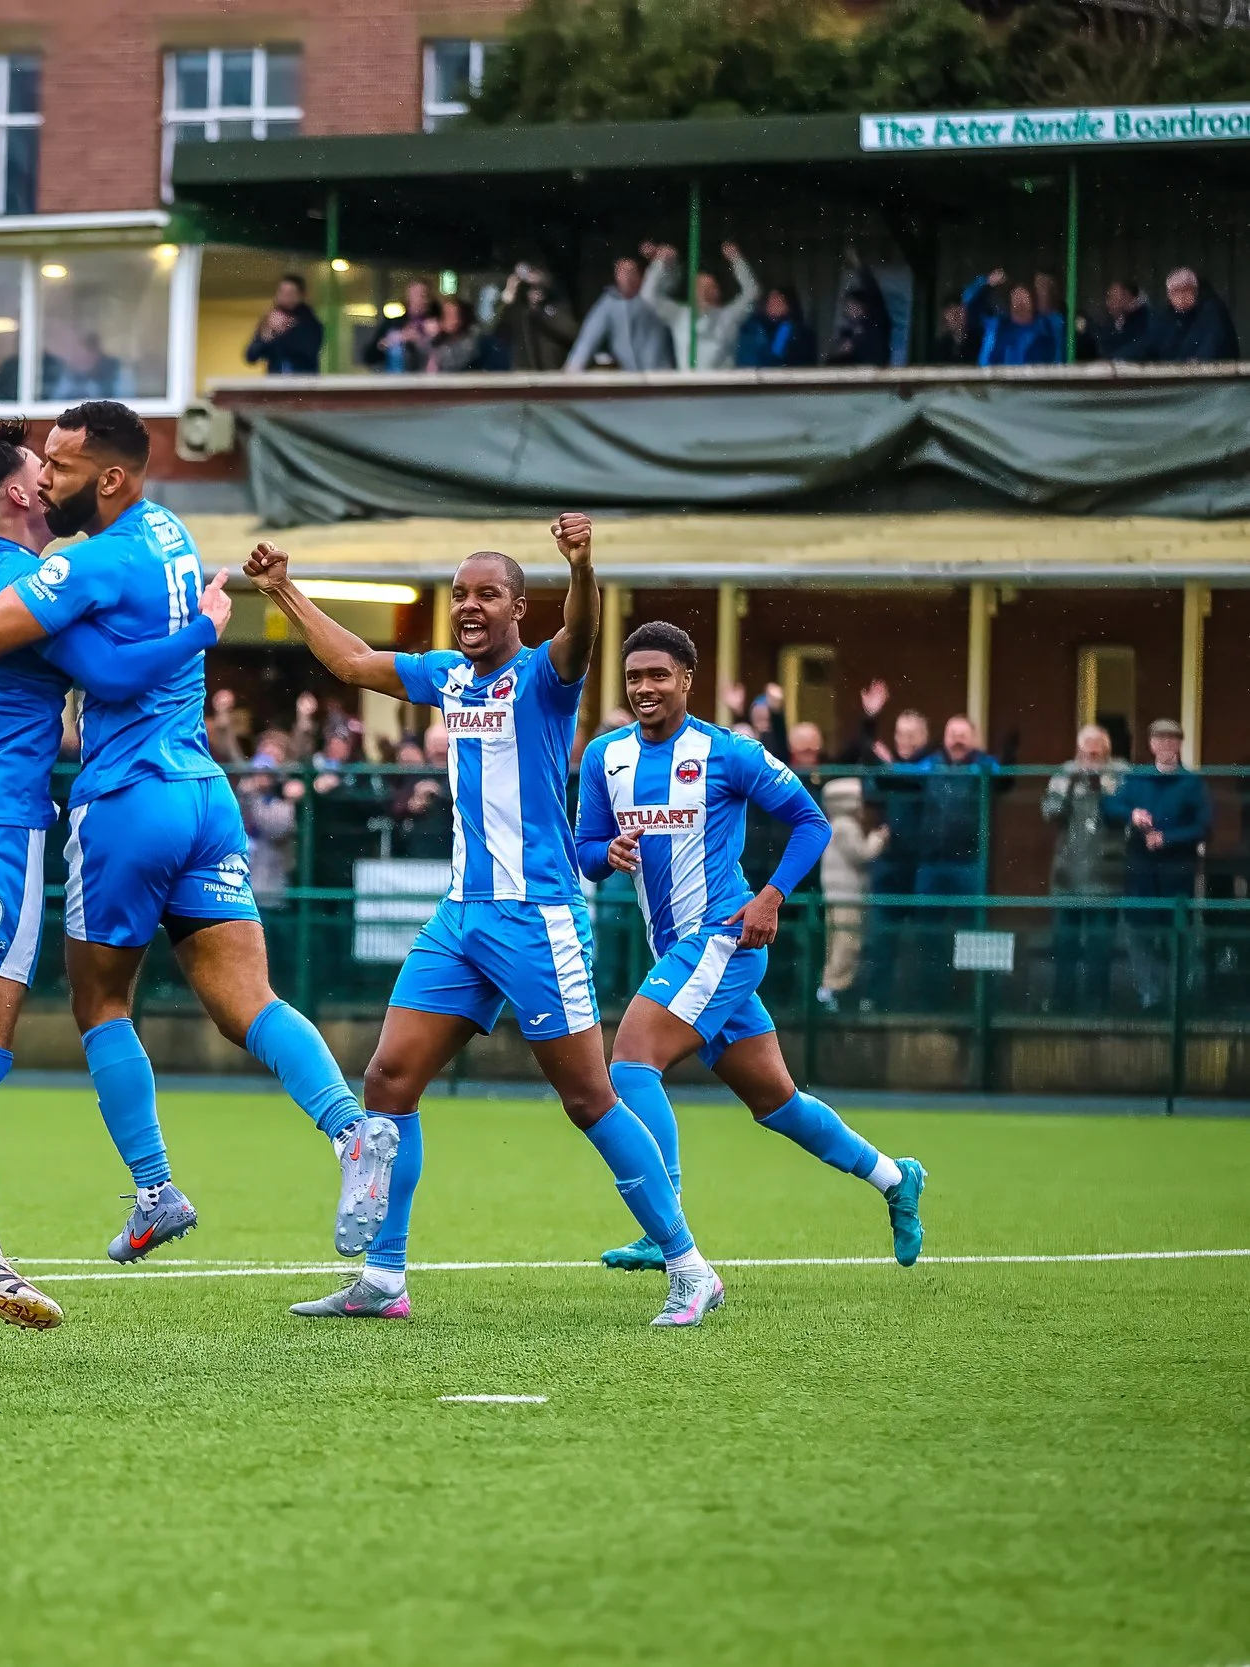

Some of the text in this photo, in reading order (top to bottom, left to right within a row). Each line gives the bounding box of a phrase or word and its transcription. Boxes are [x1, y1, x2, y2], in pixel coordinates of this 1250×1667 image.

[874, 117, 925, 147] The
[933, 114, 1003, 147] Peter
[1114, 105, 1250, 141] Boardroo
[616, 808, 699, 826] STUART
[203, 882, 239, 895] FINANCIAL
[216, 893, 222, 902] &
